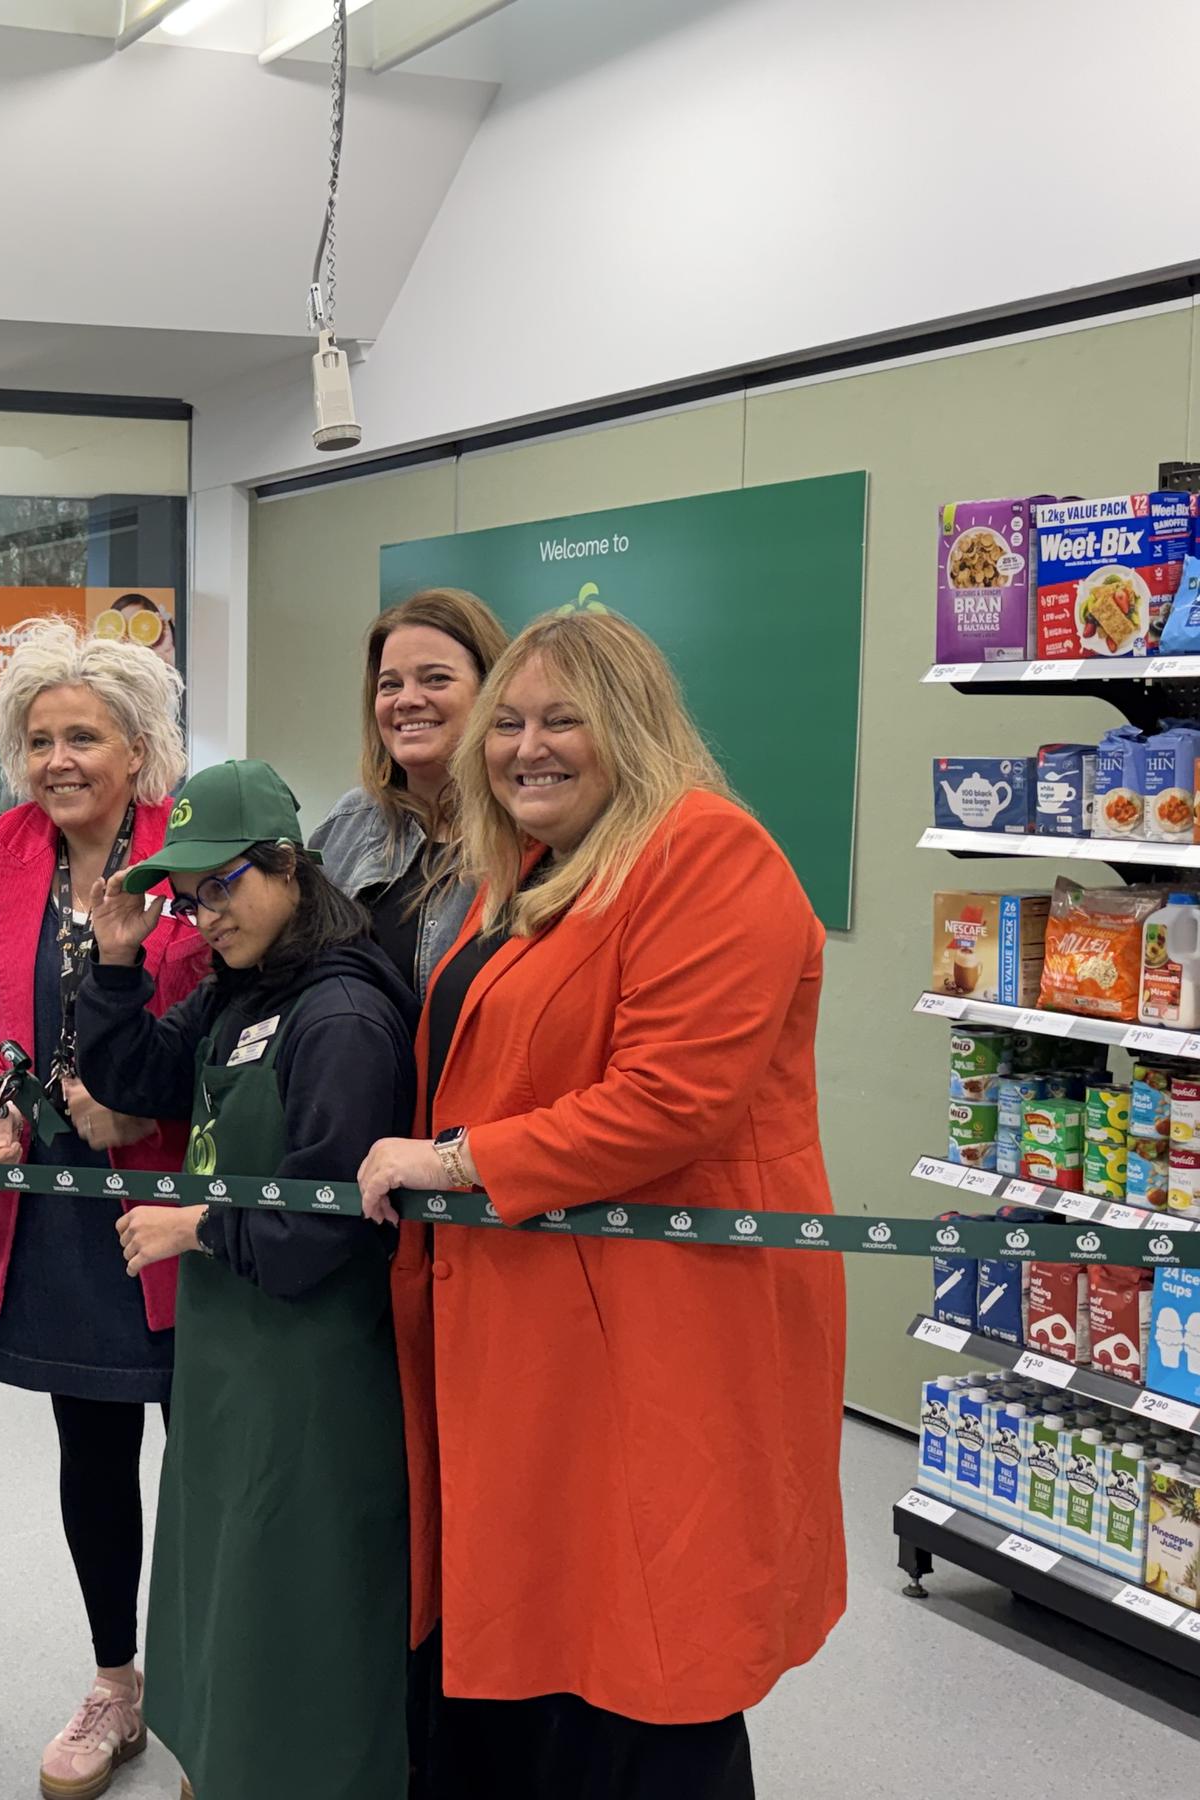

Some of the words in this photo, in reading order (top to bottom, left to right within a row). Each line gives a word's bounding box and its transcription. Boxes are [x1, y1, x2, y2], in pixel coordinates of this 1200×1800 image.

[1134, 496, 1147, 509] 72
[1041, 509, 1065, 524] 1.2kg
[1067, 505, 1098, 520] VALUE
[1101, 501, 1128, 516] PACK
[1151, 504, 1189, 517] Weet-Bix
[540, 537, 609, 562] Welcome
[613, 533, 629, 552] to
[1040, 527, 1144, 562] Weet-Bix
[954, 597, 1002, 613] BRAN
[957, 613, 1000, 624] FLAKES
[963, 623, 1000, 632] SULTANAS
[1098, 758, 1123, 771] HIN
[1004, 901, 1017, 912] 26
[1004, 920, 1014, 947] PACK
[1004, 949, 1013, 985] VALUE
[1004, 988, 1013, 1003] BIG
[952, 1042, 972, 1052] MILO
[950, 1108, 969, 1119] MILO
[1162, 1267, 1180, 1281] 24
[1162, 1283, 1193, 1299] cups
[930, 1438, 942, 1448] FULL
[927, 1445, 944, 1457] CREAM
[963, 1453, 976, 1462] FULL
[960, 1459, 978, 1471] CREAM
[1029, 1457, 1059, 1476] DEVONDALE
[1000, 1467, 1013, 1477] FULL
[997, 1474, 1015, 1486] CREAM
[1067, 1471, 1098, 1490] DEVONDALE
[1034, 1481, 1052, 1493] EXTRA
[1034, 1490, 1051, 1501] LIGHT
[1072, 1494, 1090, 1509] EXTRA
[1107, 1487, 1139, 1505] DEVONDALE
[1072, 1503, 1089, 1517] LIGHT
[1113, 1511, 1131, 1523] EXTRA
[1113, 1519, 1130, 1533] LIGHT
[1152, 1524, 1194, 1549] Pineapple
[1159, 1538, 1183, 1553] Juice
